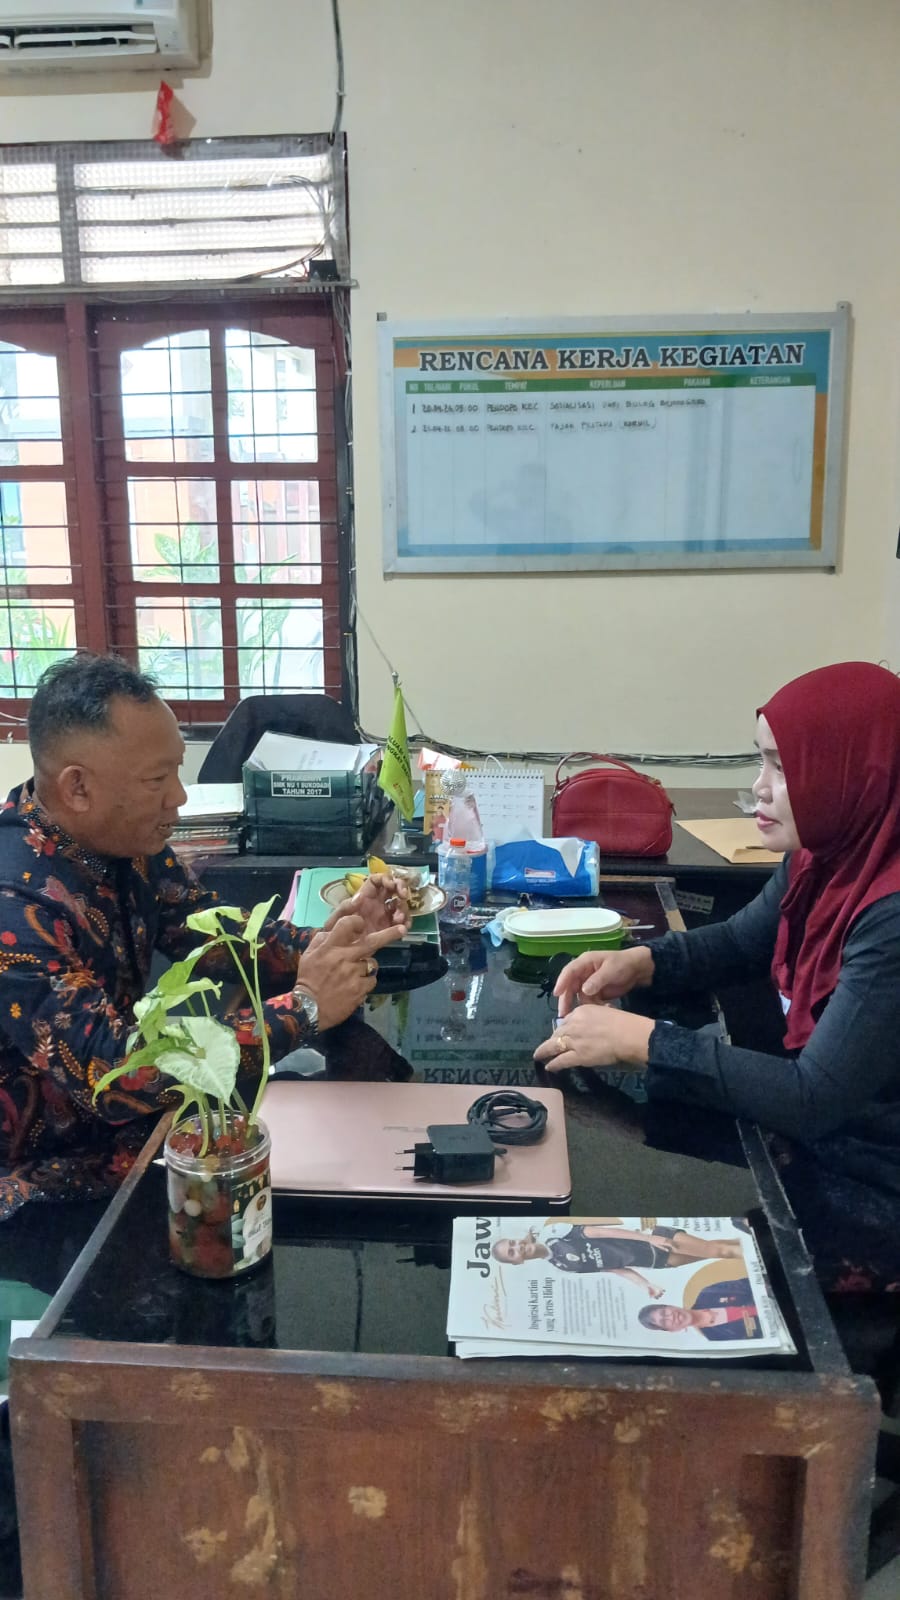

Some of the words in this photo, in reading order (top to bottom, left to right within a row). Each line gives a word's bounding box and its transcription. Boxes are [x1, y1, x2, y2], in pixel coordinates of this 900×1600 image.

[419, 350, 549, 372] RENCANA
[557, 348, 651, 371] KERJA
[660, 344, 806, 367] KEGIATAN
[504, 381, 528, 391] TEMPAT
[589, 379, 626, 389] KEPERLUAN
[683, 377, 711, 387] PAKAIAN
[749, 376, 791, 385] KETERANGAN
[466, 1217, 492, 1279] Jaw
[527, 1279, 539, 1304] Kartini
